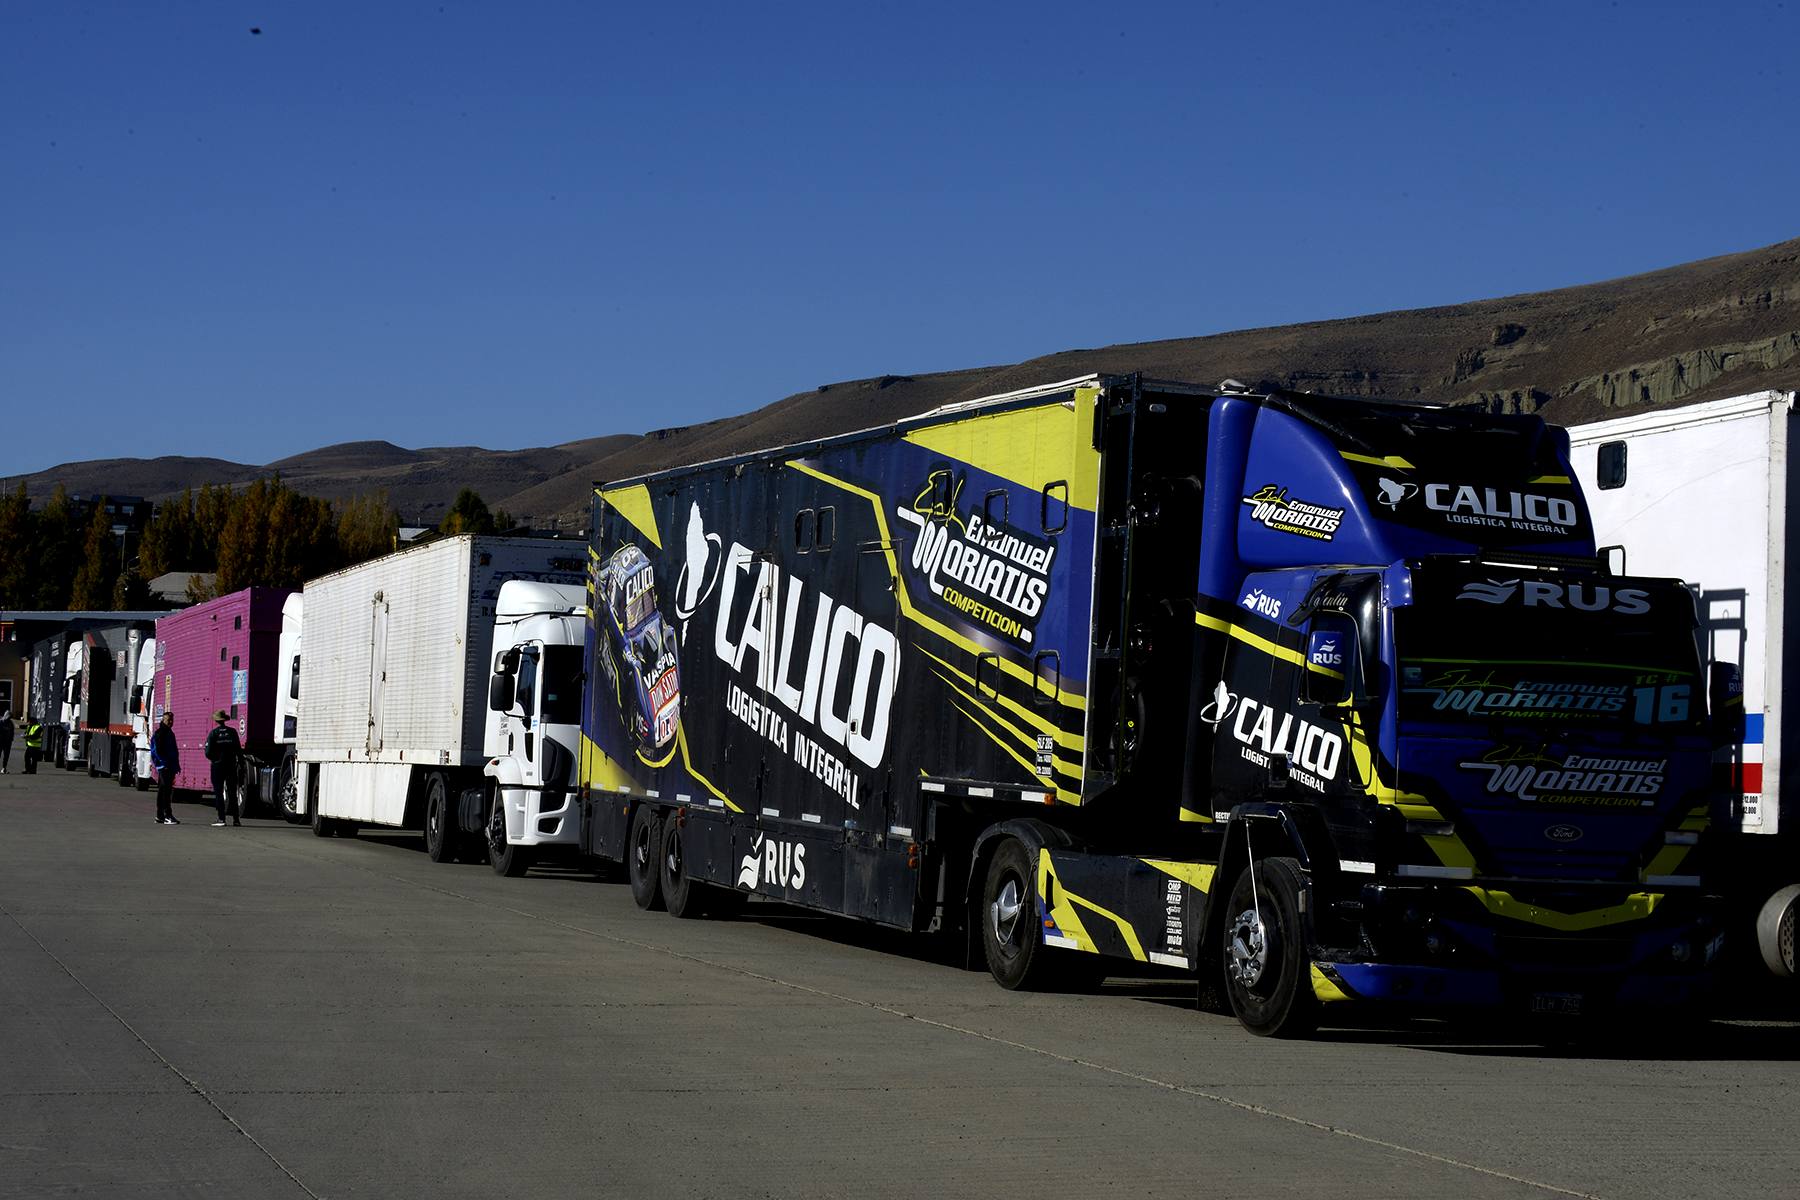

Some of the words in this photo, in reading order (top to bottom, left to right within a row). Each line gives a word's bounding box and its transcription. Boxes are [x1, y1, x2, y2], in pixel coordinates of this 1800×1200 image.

[1243, 497, 1341, 533] MORIATIS
[1287, 499, 1344, 520] Emanuel
[1424, 483, 1577, 526] CALICO
[1273, 523, 1325, 539] COMPETICION
[1446, 514, 1506, 528] LOGISTICA
[1511, 520, 1569, 535] INTEGRAL
[897, 506, 1048, 618] MORIATIS
[626, 566, 656, 605] CALICO
[1523, 580, 1653, 615] RUS
[943, 587, 1022, 640] COMPETICION
[1257, 594, 1281, 618] RUS
[643, 651, 677, 690] VASPIA
[714, 541, 902, 770] CALICO
[1312, 652, 1343, 665] RUS
[1513, 680, 1630, 696] Emanuel
[1632, 684, 1692, 726] 16
[726, 680, 788, 754] LOGISTICA
[794, 730, 860, 810] INTEGRAL
[1233, 696, 1342, 781] CALICO
[1289, 767, 1326, 794] INTEGRAL
[1459, 762, 1665, 801] MORIATIS
[1563, 755, 1668, 774] Emanuel
[1538, 794, 1641, 808] COMPETICION
[764, 837, 806, 891] RUS
